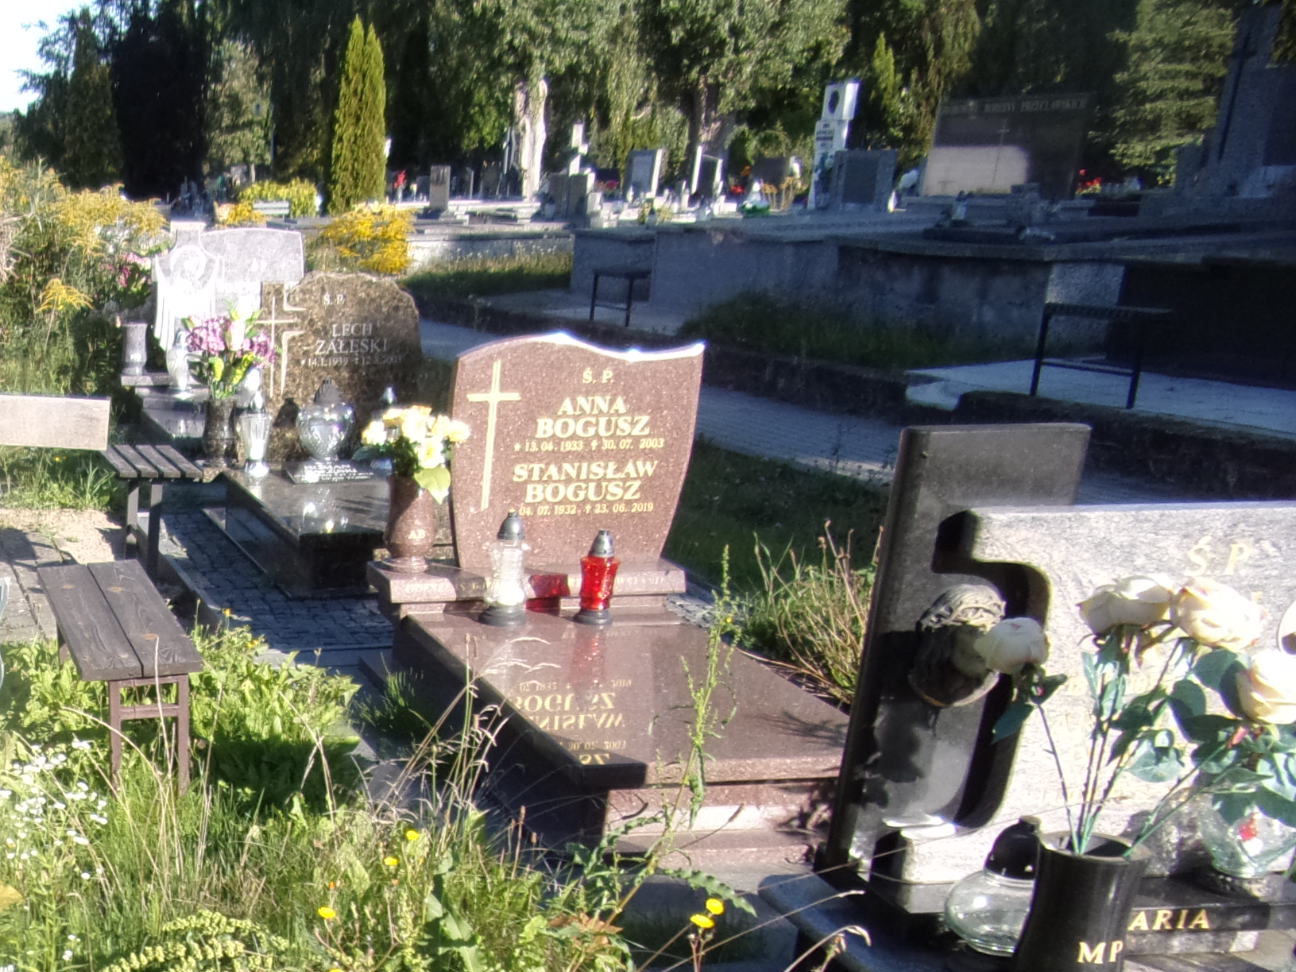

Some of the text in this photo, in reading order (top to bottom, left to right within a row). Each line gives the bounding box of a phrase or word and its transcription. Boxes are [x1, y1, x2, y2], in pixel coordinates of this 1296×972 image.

[331, 322, 373, 337] LECH
[556, 394, 627, 415] ANNA
[534, 415, 651, 439] BOGUSZ
[639, 438, 665, 449] 2003
[512, 460, 658, 482] STANISŁAW
[524, 480, 642, 503] BOGUSZ
[631, 502, 654, 512] 2019
[1127, 908, 1211, 931] ARIA
